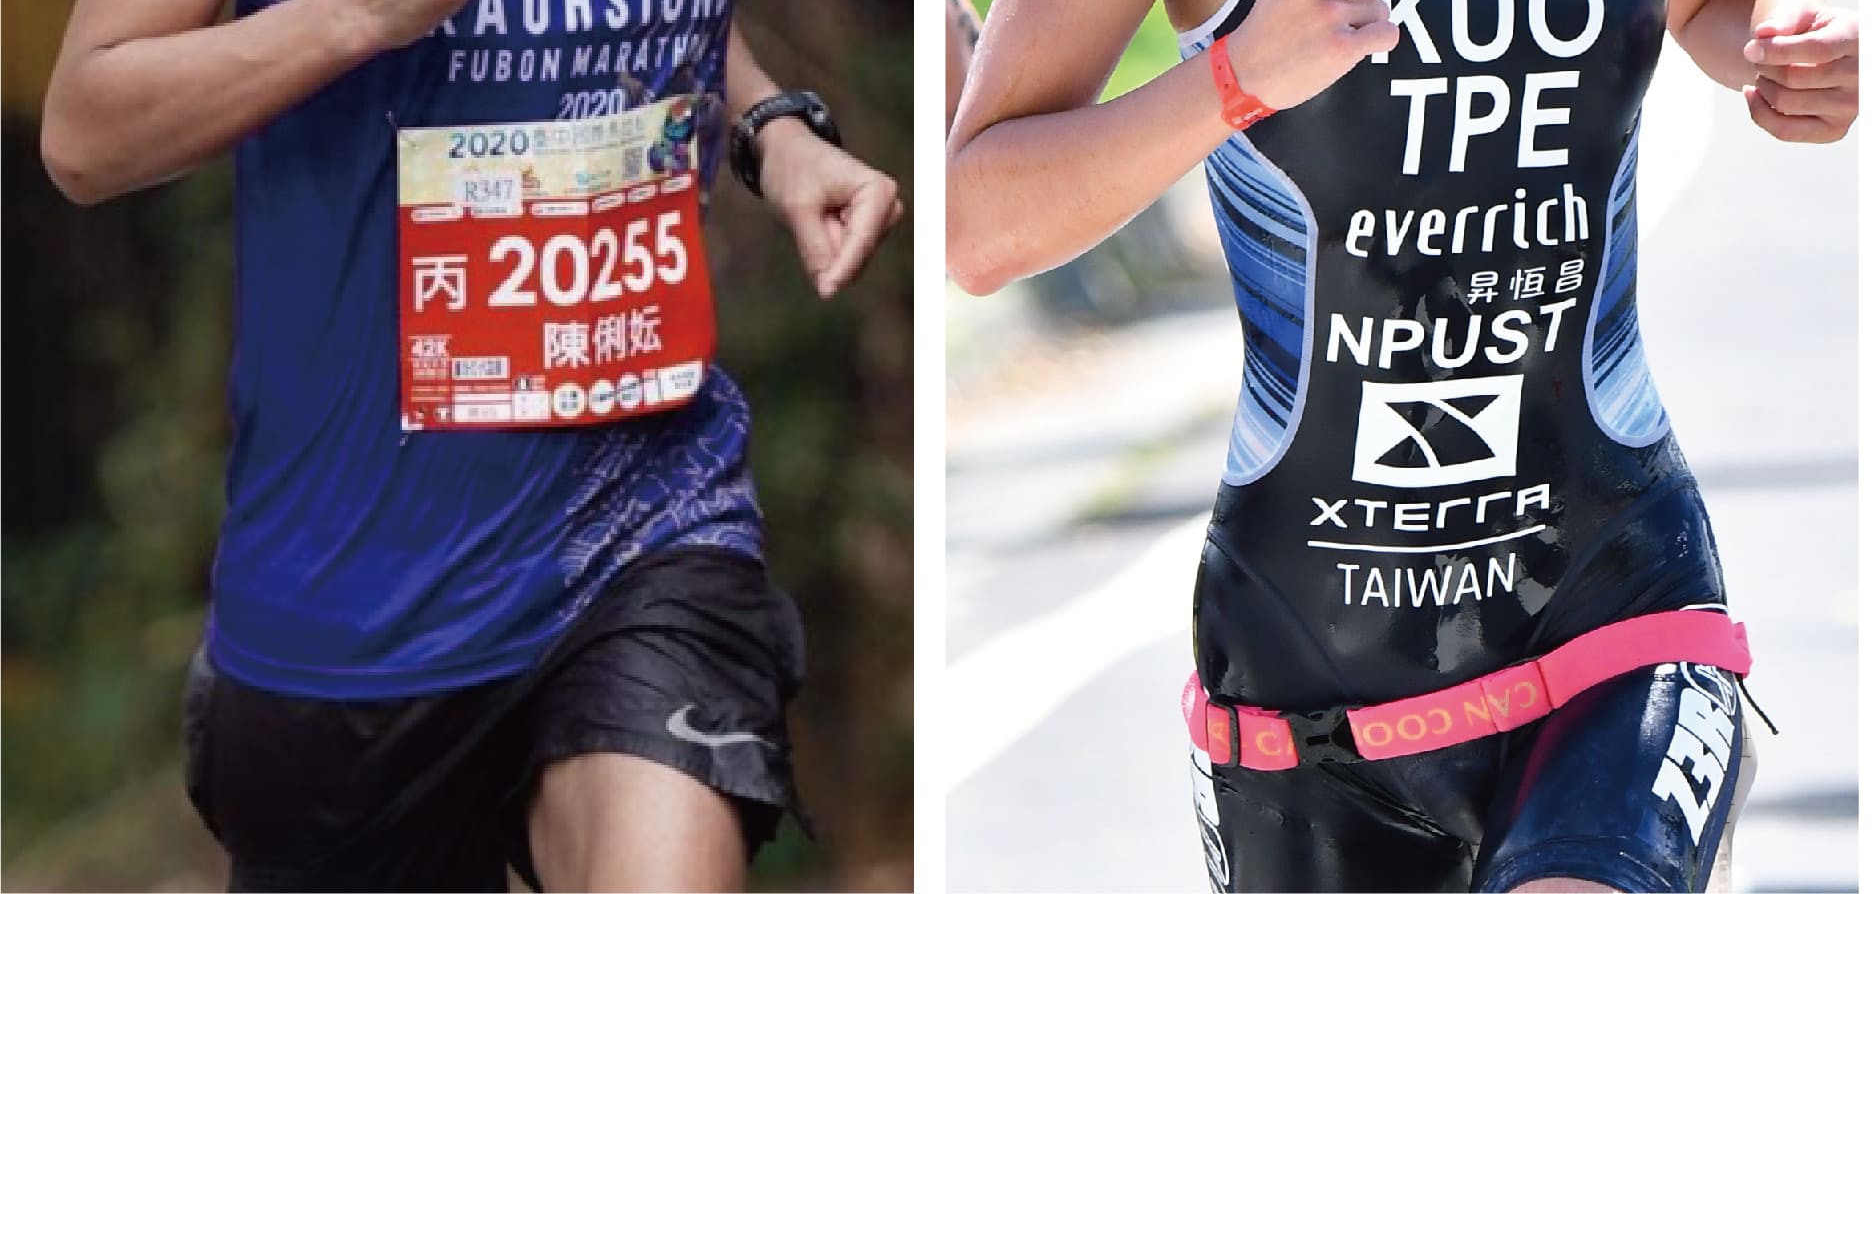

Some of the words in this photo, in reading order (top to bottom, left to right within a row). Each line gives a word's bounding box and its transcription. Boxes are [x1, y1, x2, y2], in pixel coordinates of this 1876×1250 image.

[449, 48, 561, 82] FUBON
[448, 129, 530, 159] 2020
[1390, 71, 1580, 175] TPE
[464, 179, 514, 199] R347
[1345, 184, 1589, 257] everrich
[412, 255, 467, 312] 丙
[487, 210, 688, 307] 20255
[1326, 298, 1576, 370] NPUST
[1309, 484, 1550, 531] XTERRA
[1336, 552, 1516, 608] TAIWAN
[1353, 708, 1452, 747] COO
